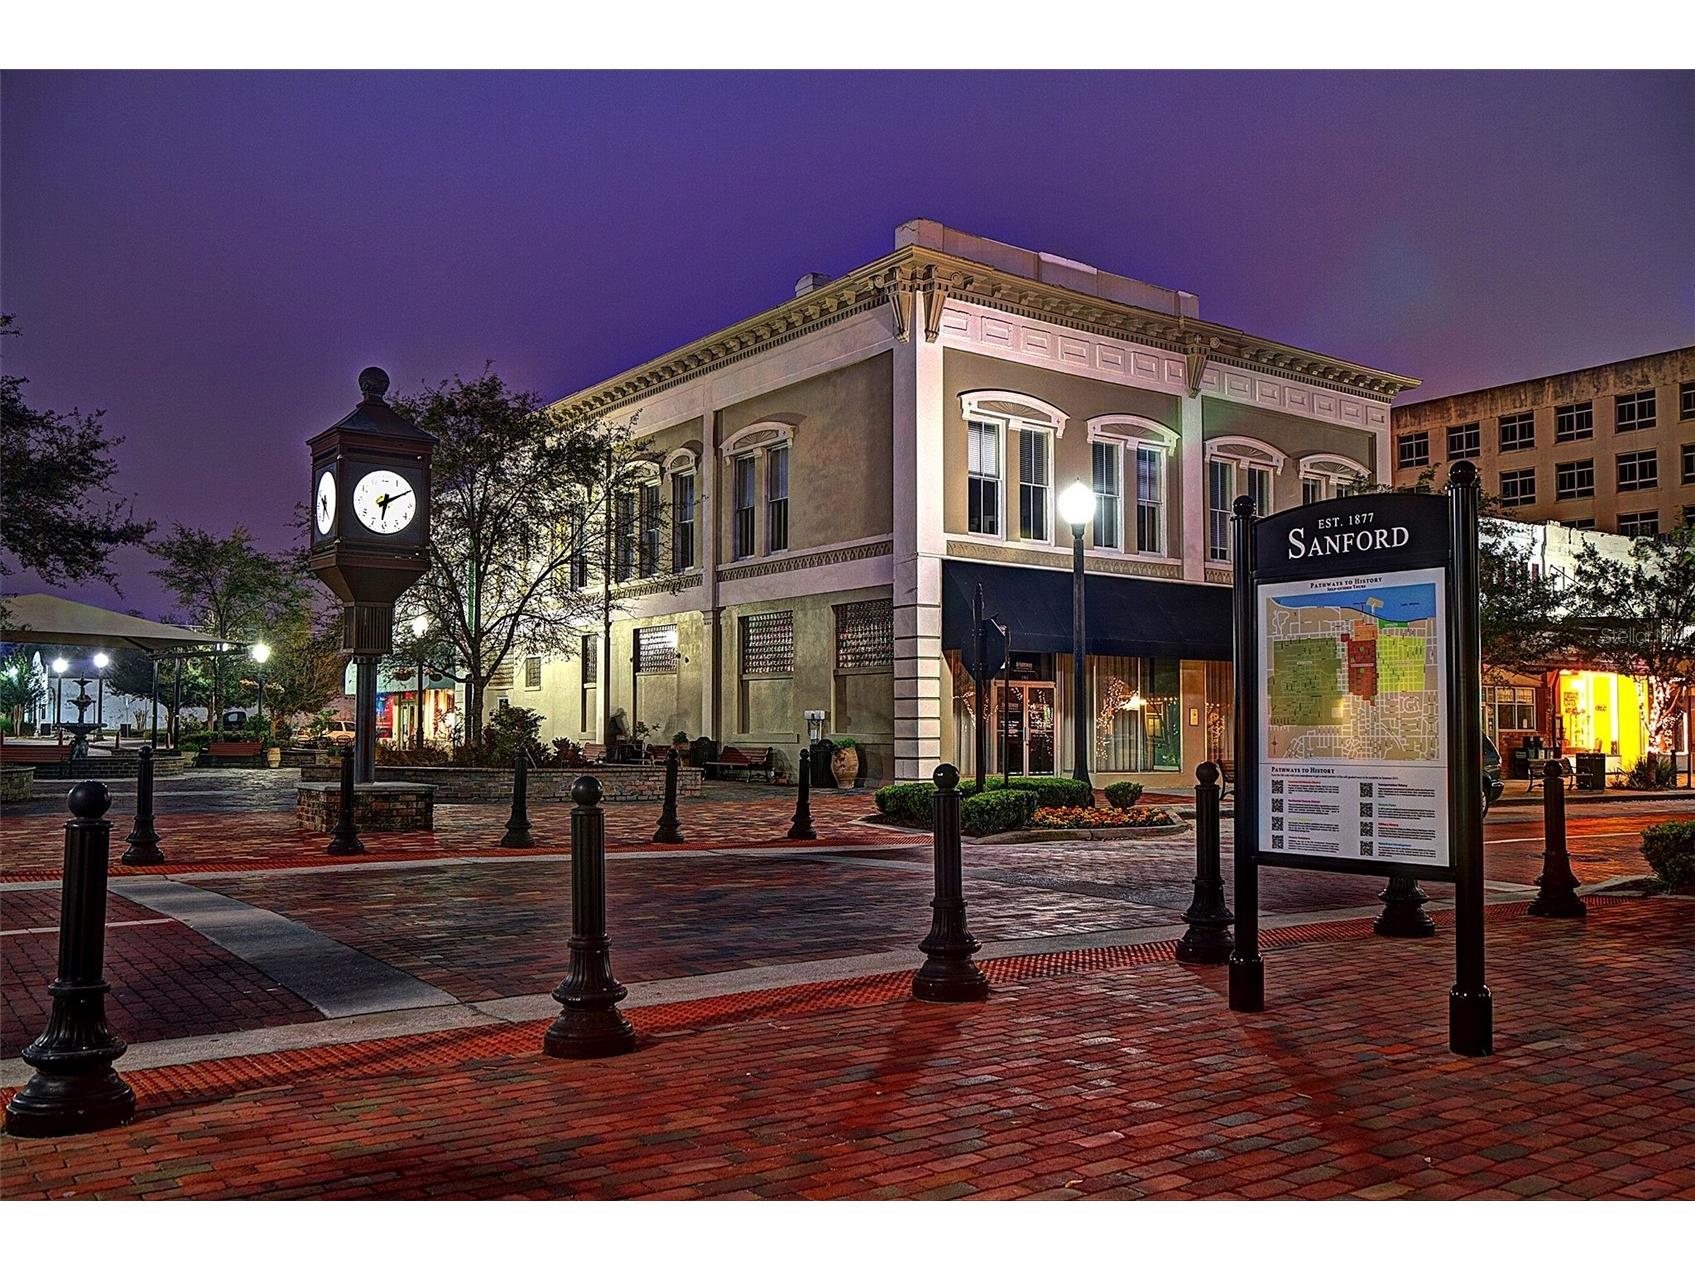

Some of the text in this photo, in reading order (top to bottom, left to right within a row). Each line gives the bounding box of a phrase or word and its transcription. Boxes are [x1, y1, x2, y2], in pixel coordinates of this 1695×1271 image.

[1318, 512, 1374, 529] EST. 1877
[1288, 526, 1410, 559] SANFORD
[1310, 581, 1343, 589] PATHWAYS
[1355, 577, 1382, 585] HISTORY
